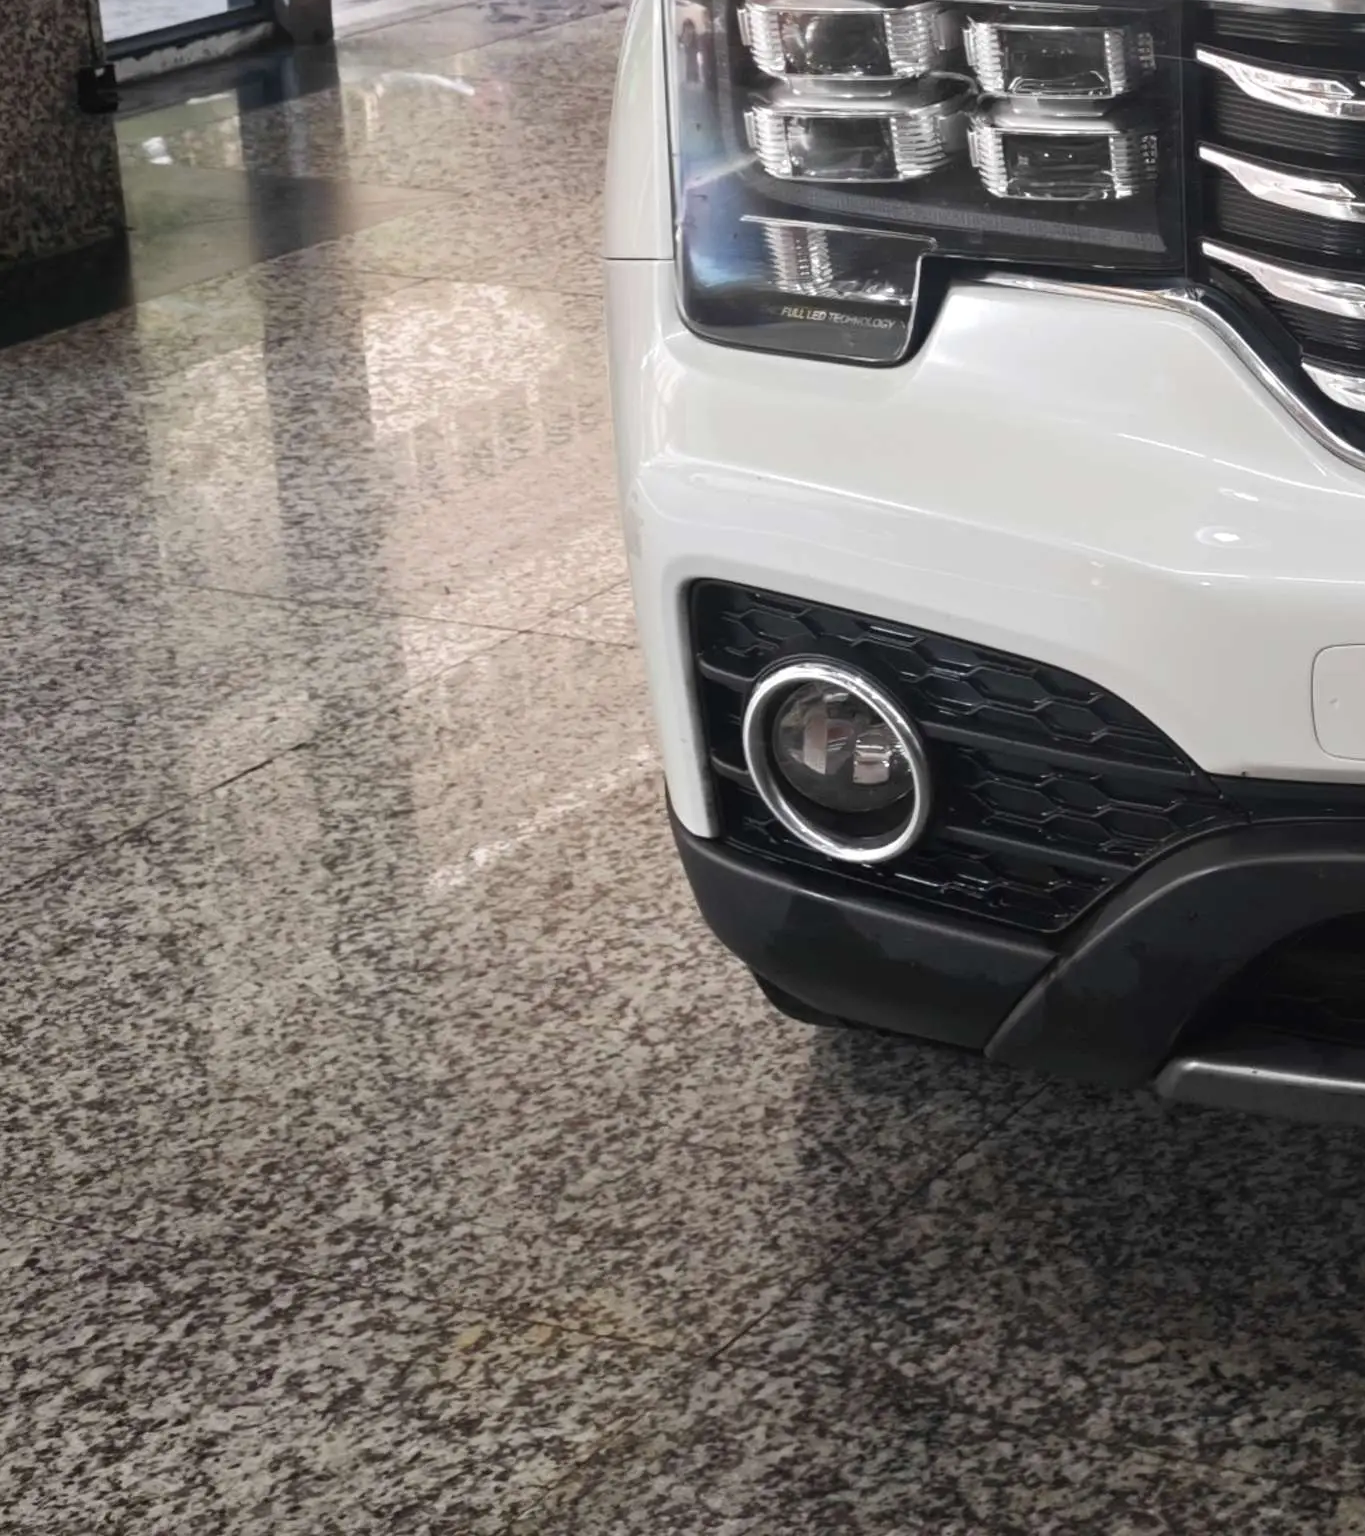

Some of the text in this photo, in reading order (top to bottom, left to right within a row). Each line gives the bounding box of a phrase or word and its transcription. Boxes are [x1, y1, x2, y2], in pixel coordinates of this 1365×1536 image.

[781, 305, 897, 329] FULL LED TECHNOLOGY
